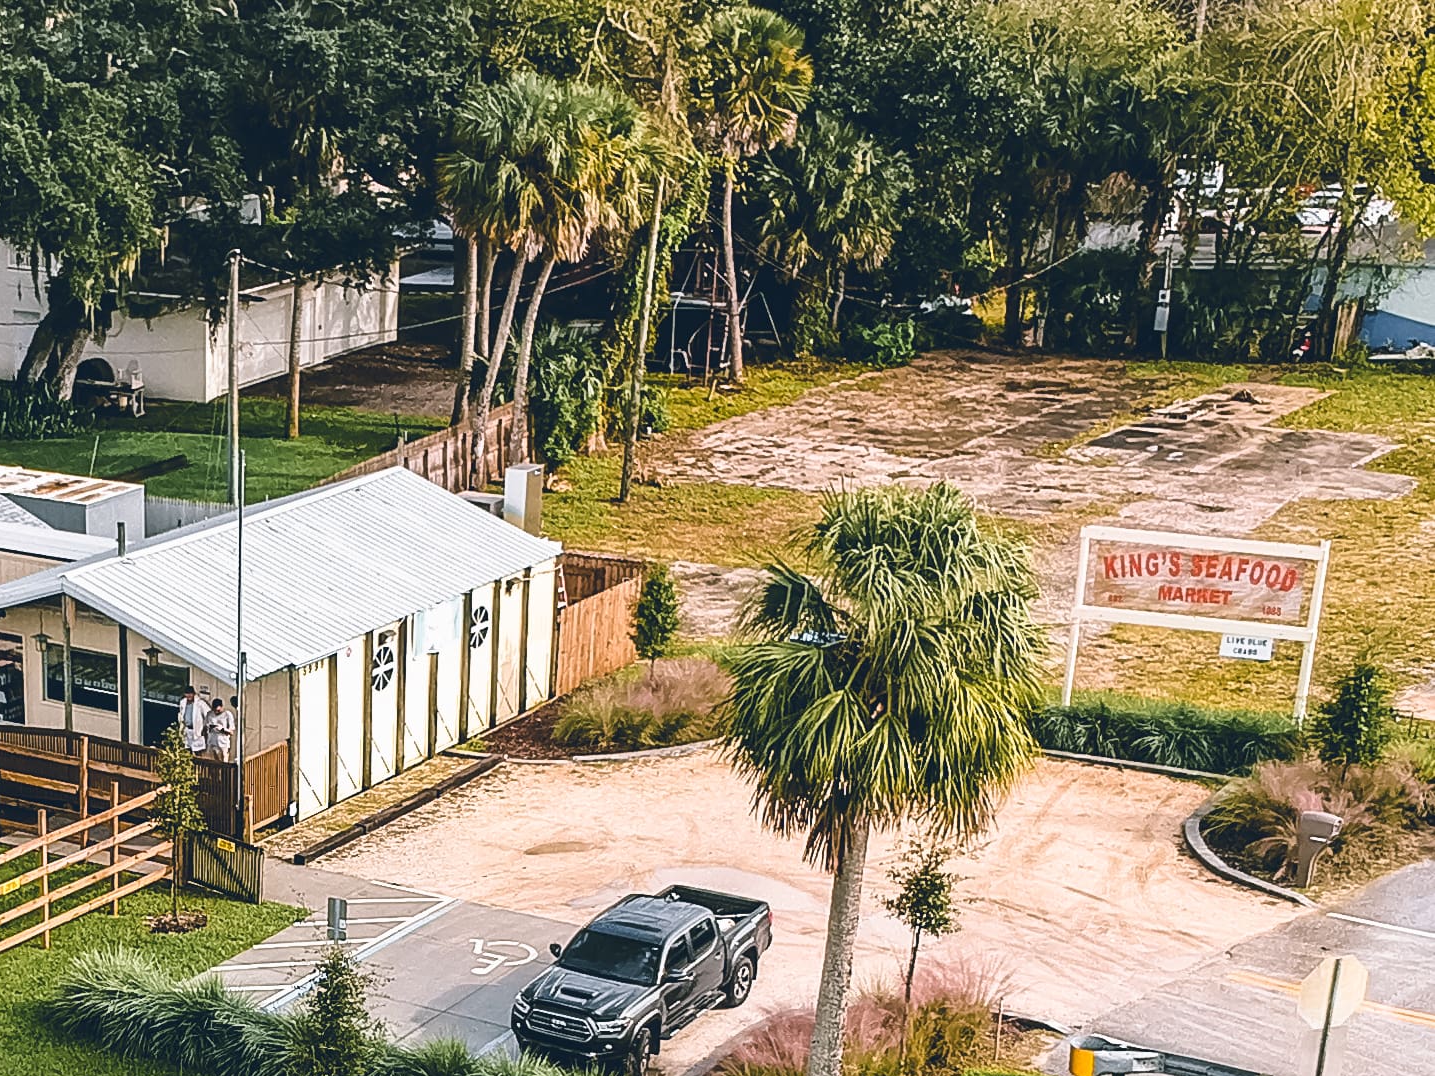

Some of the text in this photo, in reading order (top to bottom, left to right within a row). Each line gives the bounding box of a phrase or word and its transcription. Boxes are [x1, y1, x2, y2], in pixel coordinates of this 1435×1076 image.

[1103, 551, 1298, 593] KING'S SEAFOOD
[1158, 585, 1233, 605] MARKET
